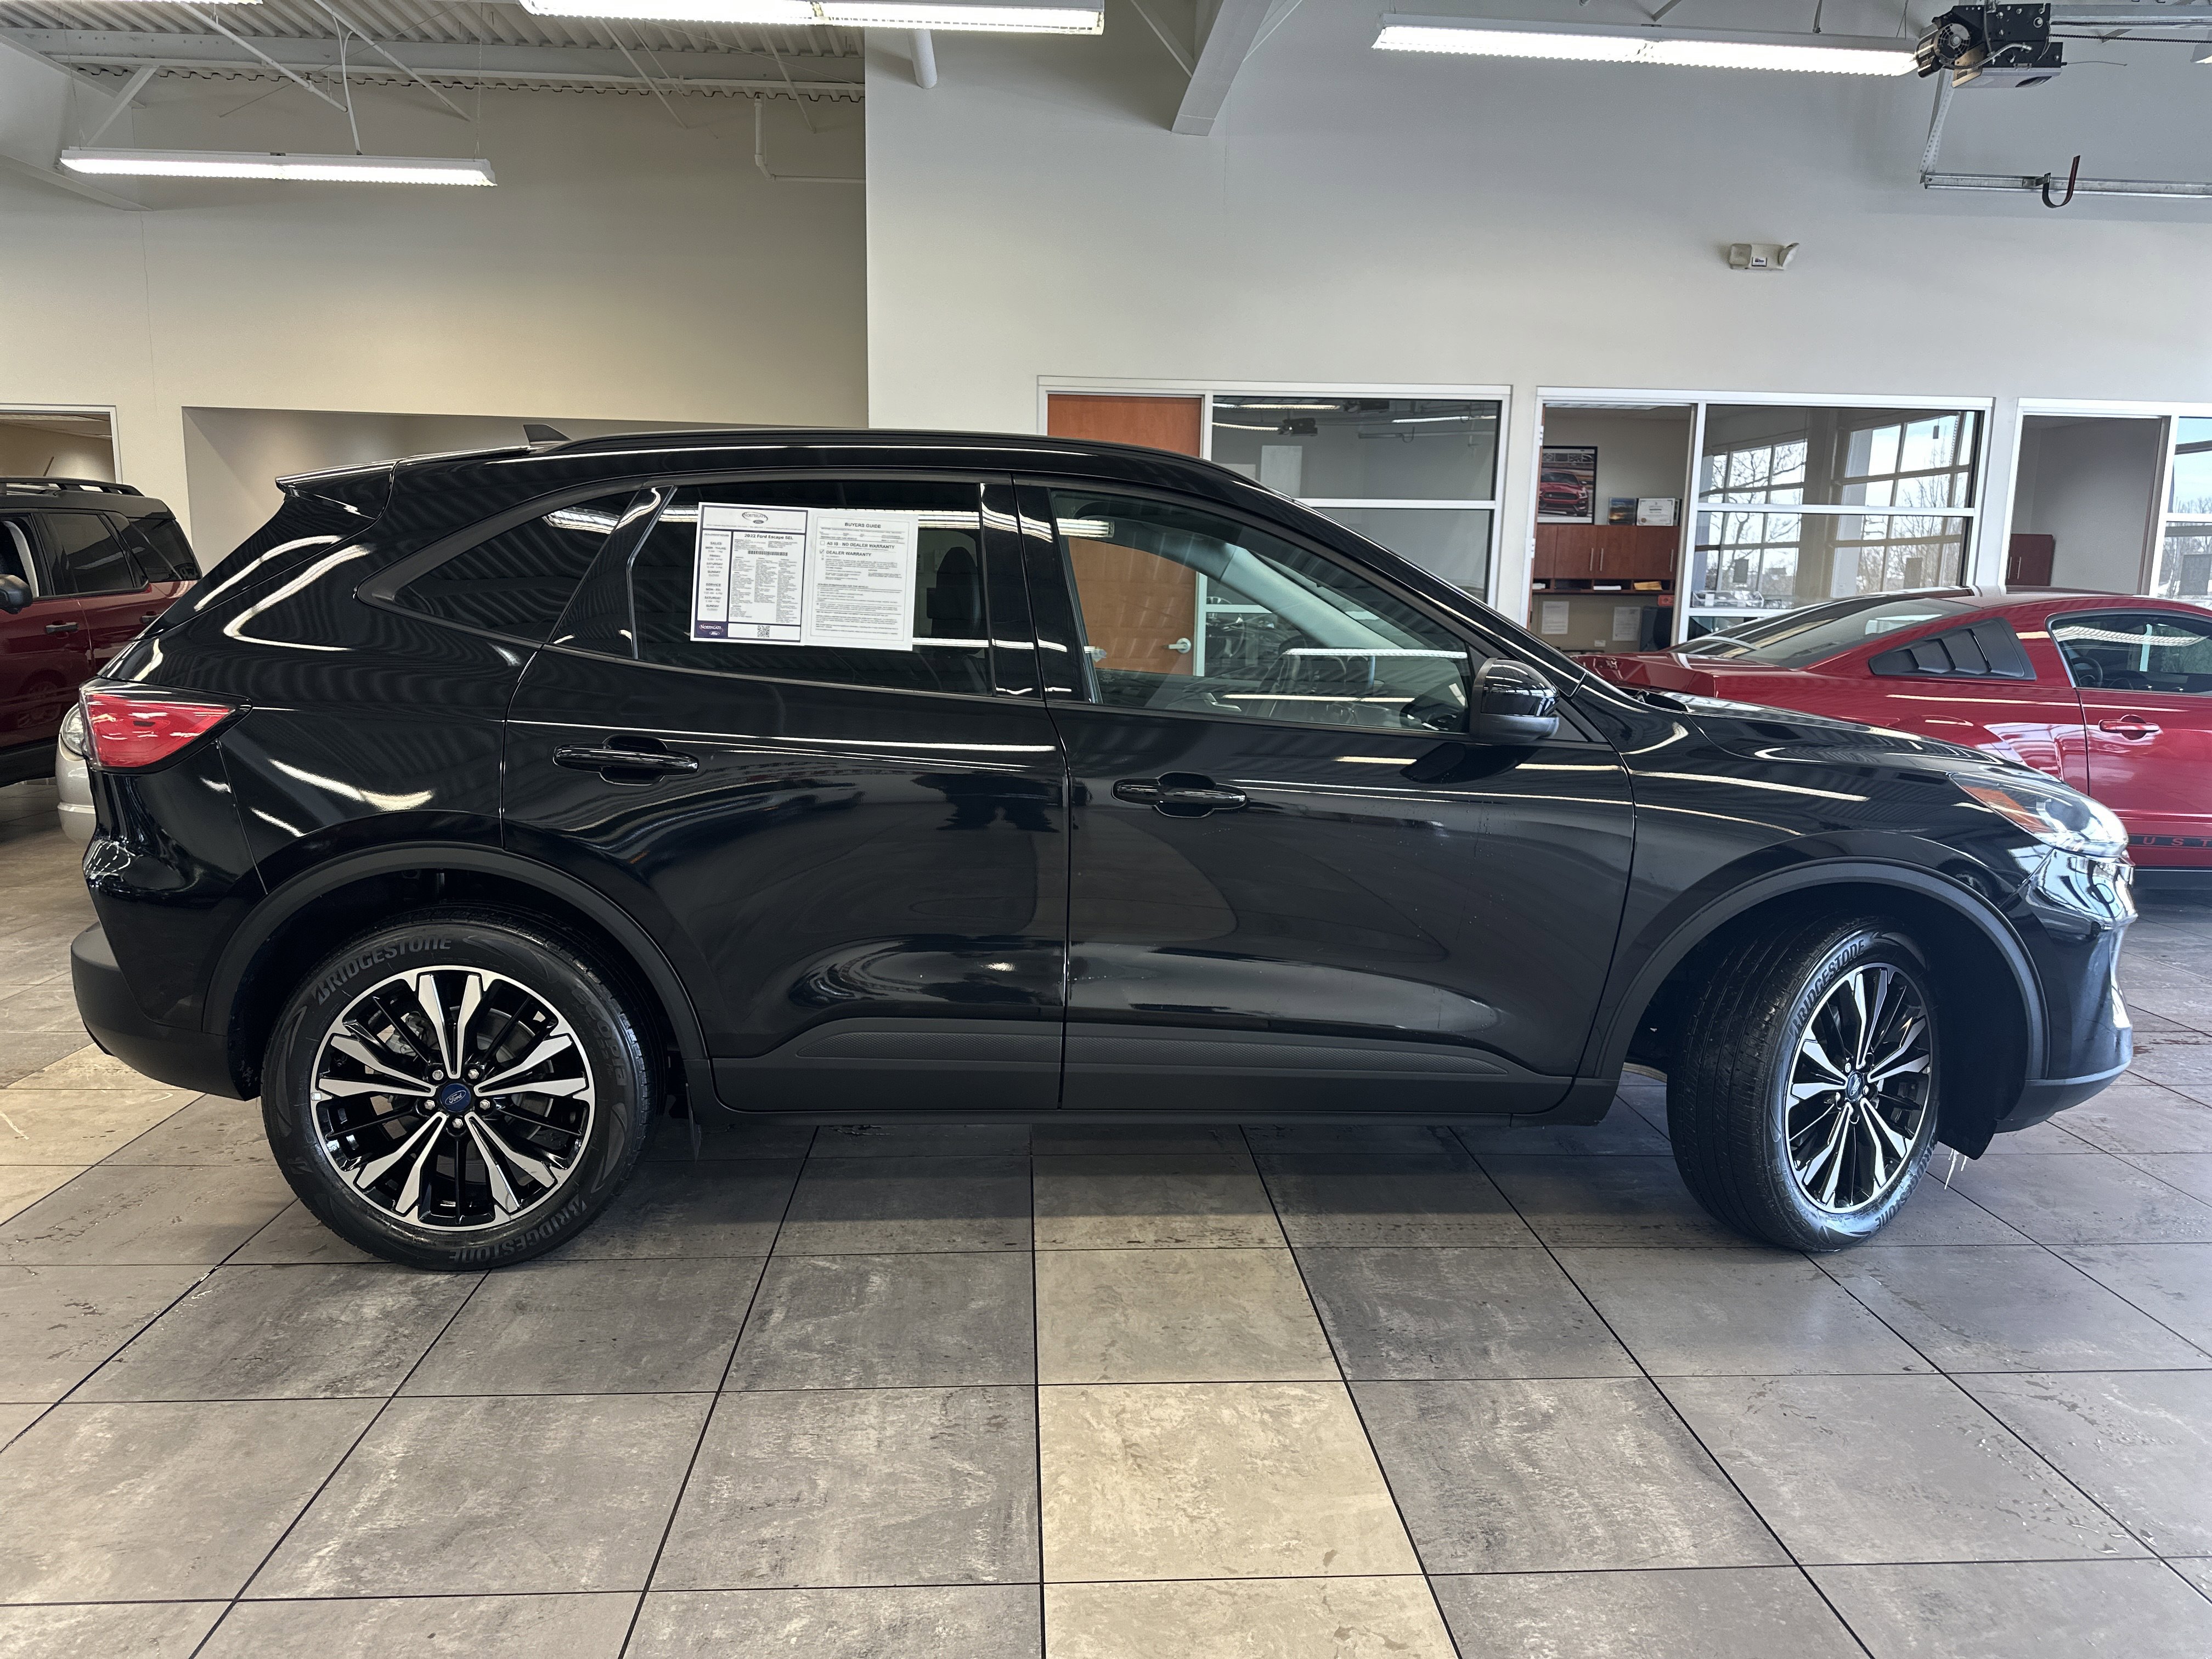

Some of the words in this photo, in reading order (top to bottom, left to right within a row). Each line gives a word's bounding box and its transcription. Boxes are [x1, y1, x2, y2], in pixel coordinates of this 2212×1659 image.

[312, 936, 452, 1005] BRIDGESTONE
[1788, 939, 1865, 1042] BRIDGESTONE
[448, 1092, 463, 1104] Ford
[449, 1193, 587, 1263] BRIDGESTONE
